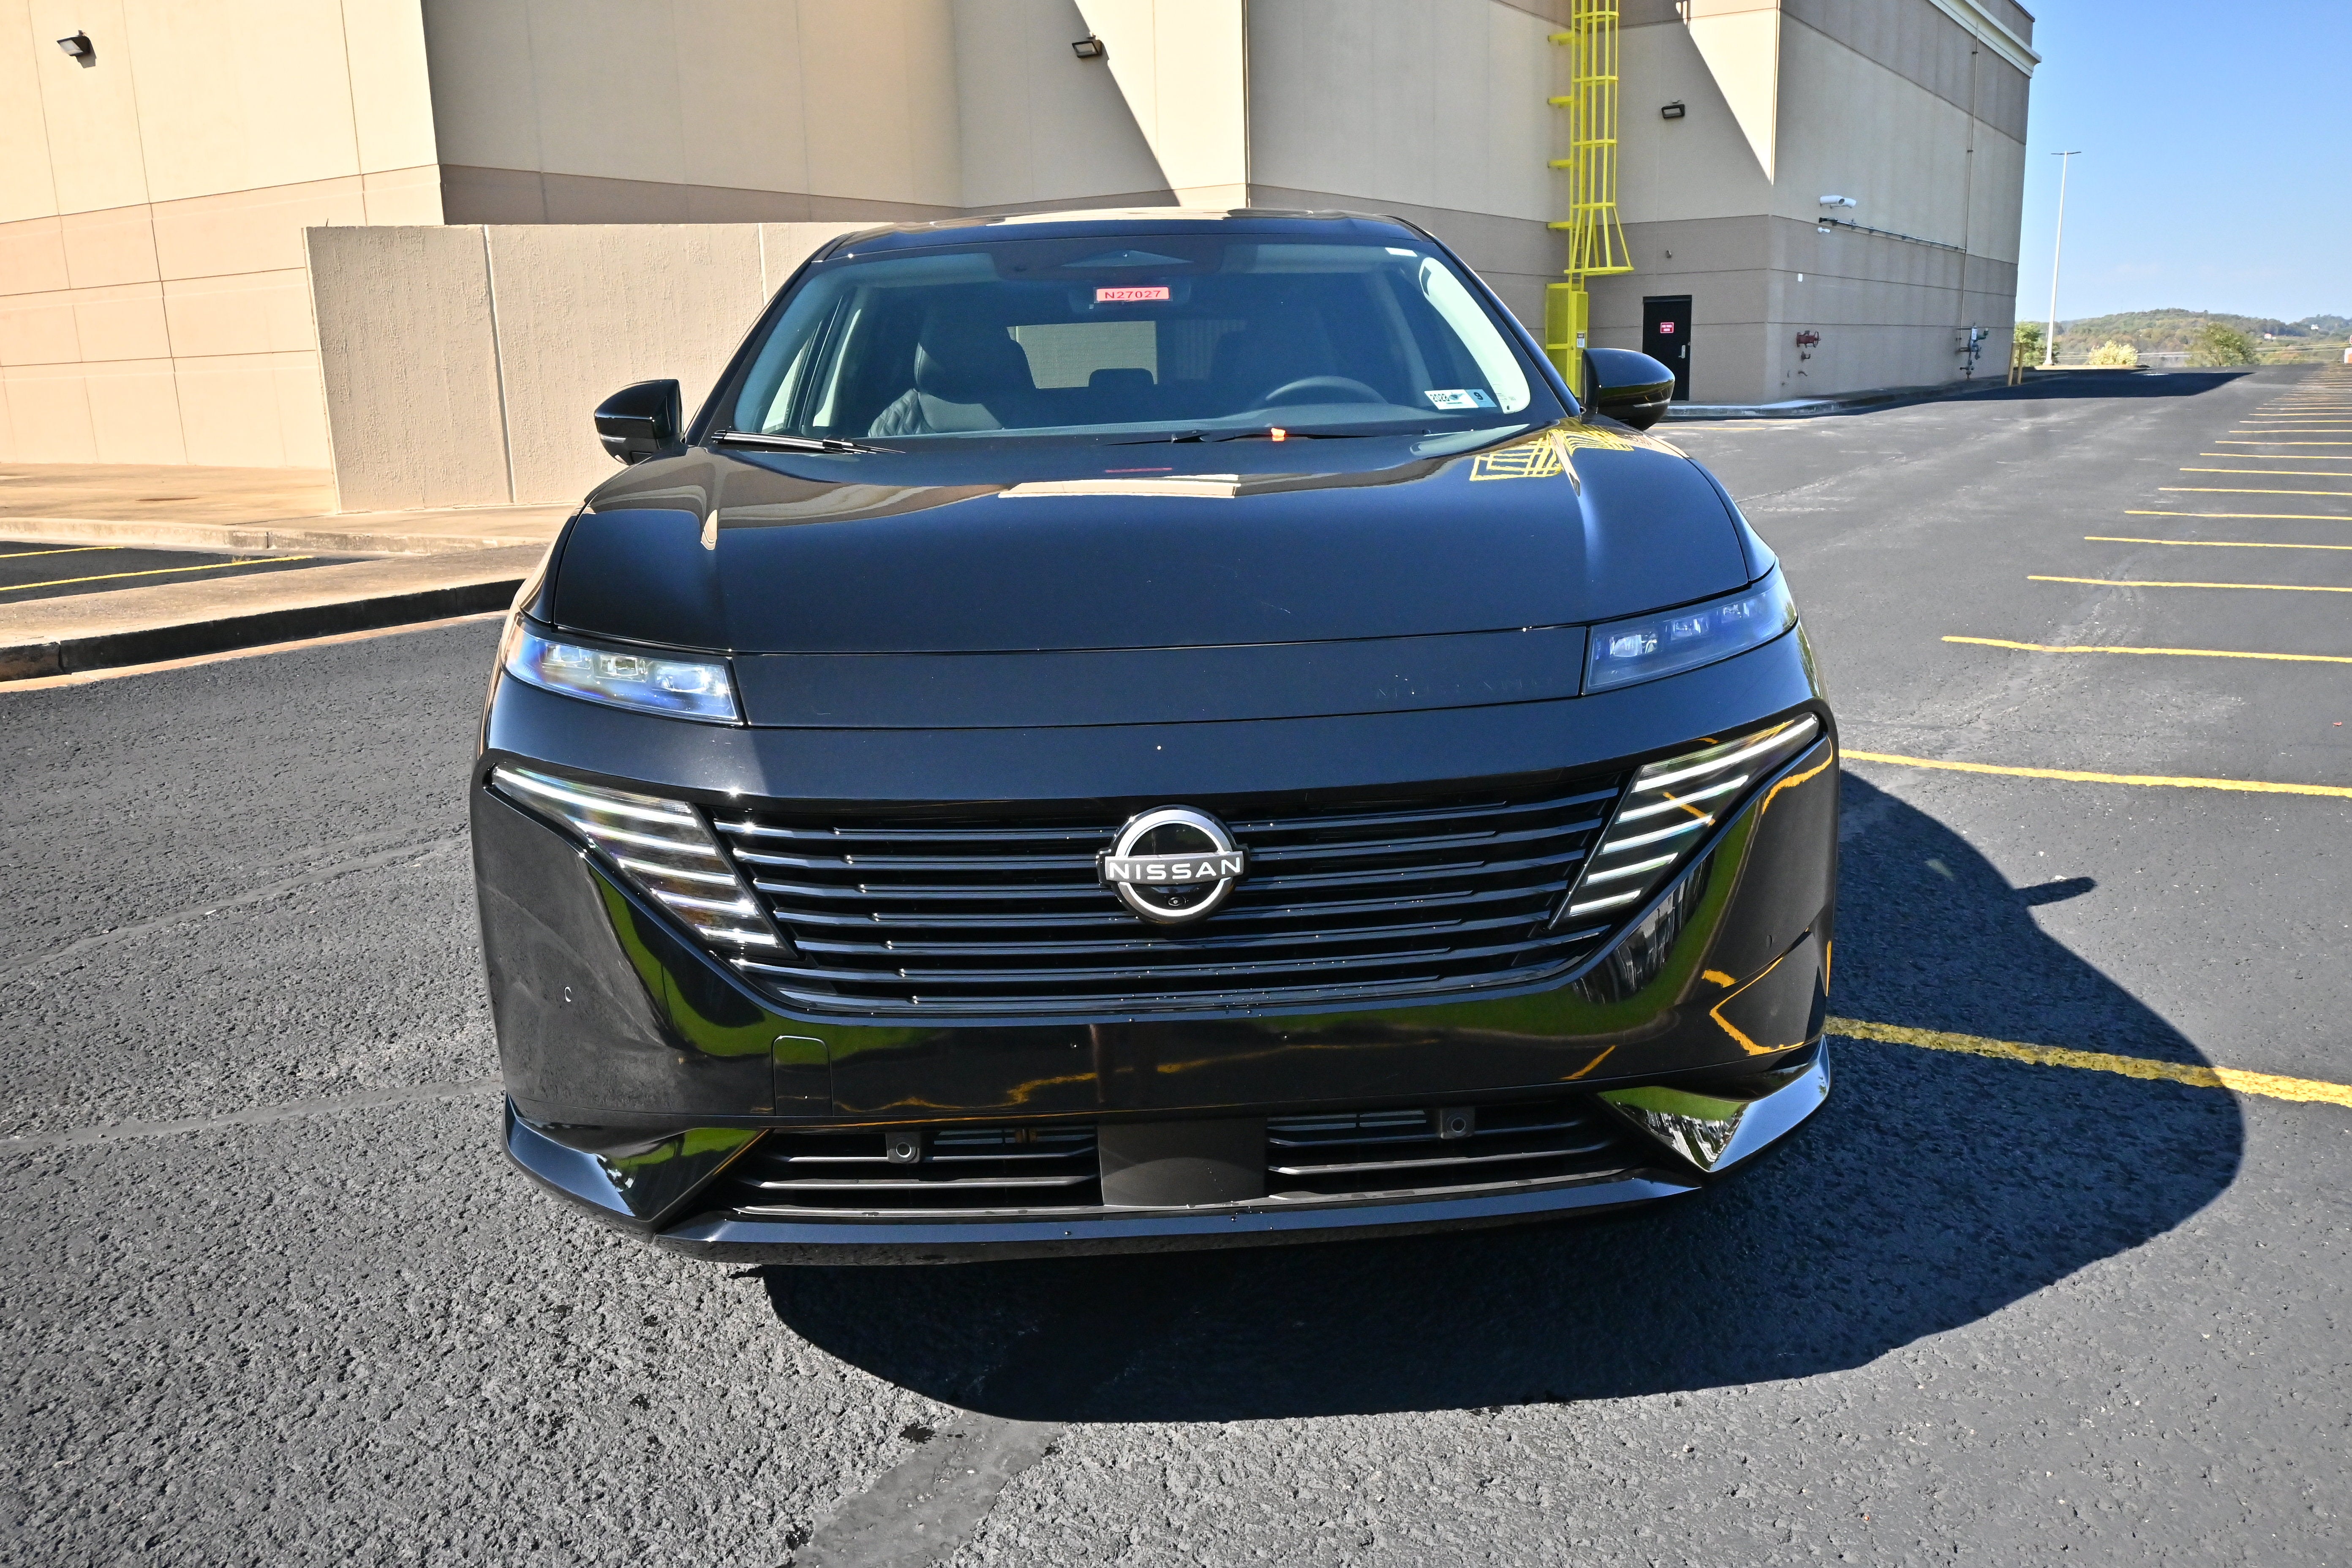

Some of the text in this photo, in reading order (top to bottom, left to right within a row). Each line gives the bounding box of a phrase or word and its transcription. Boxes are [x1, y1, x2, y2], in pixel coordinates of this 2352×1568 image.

[1105, 290, 1161, 299] N27027
[1473, 392, 1484, 400] 9
[1109, 857, 1241, 880] NISSAN
